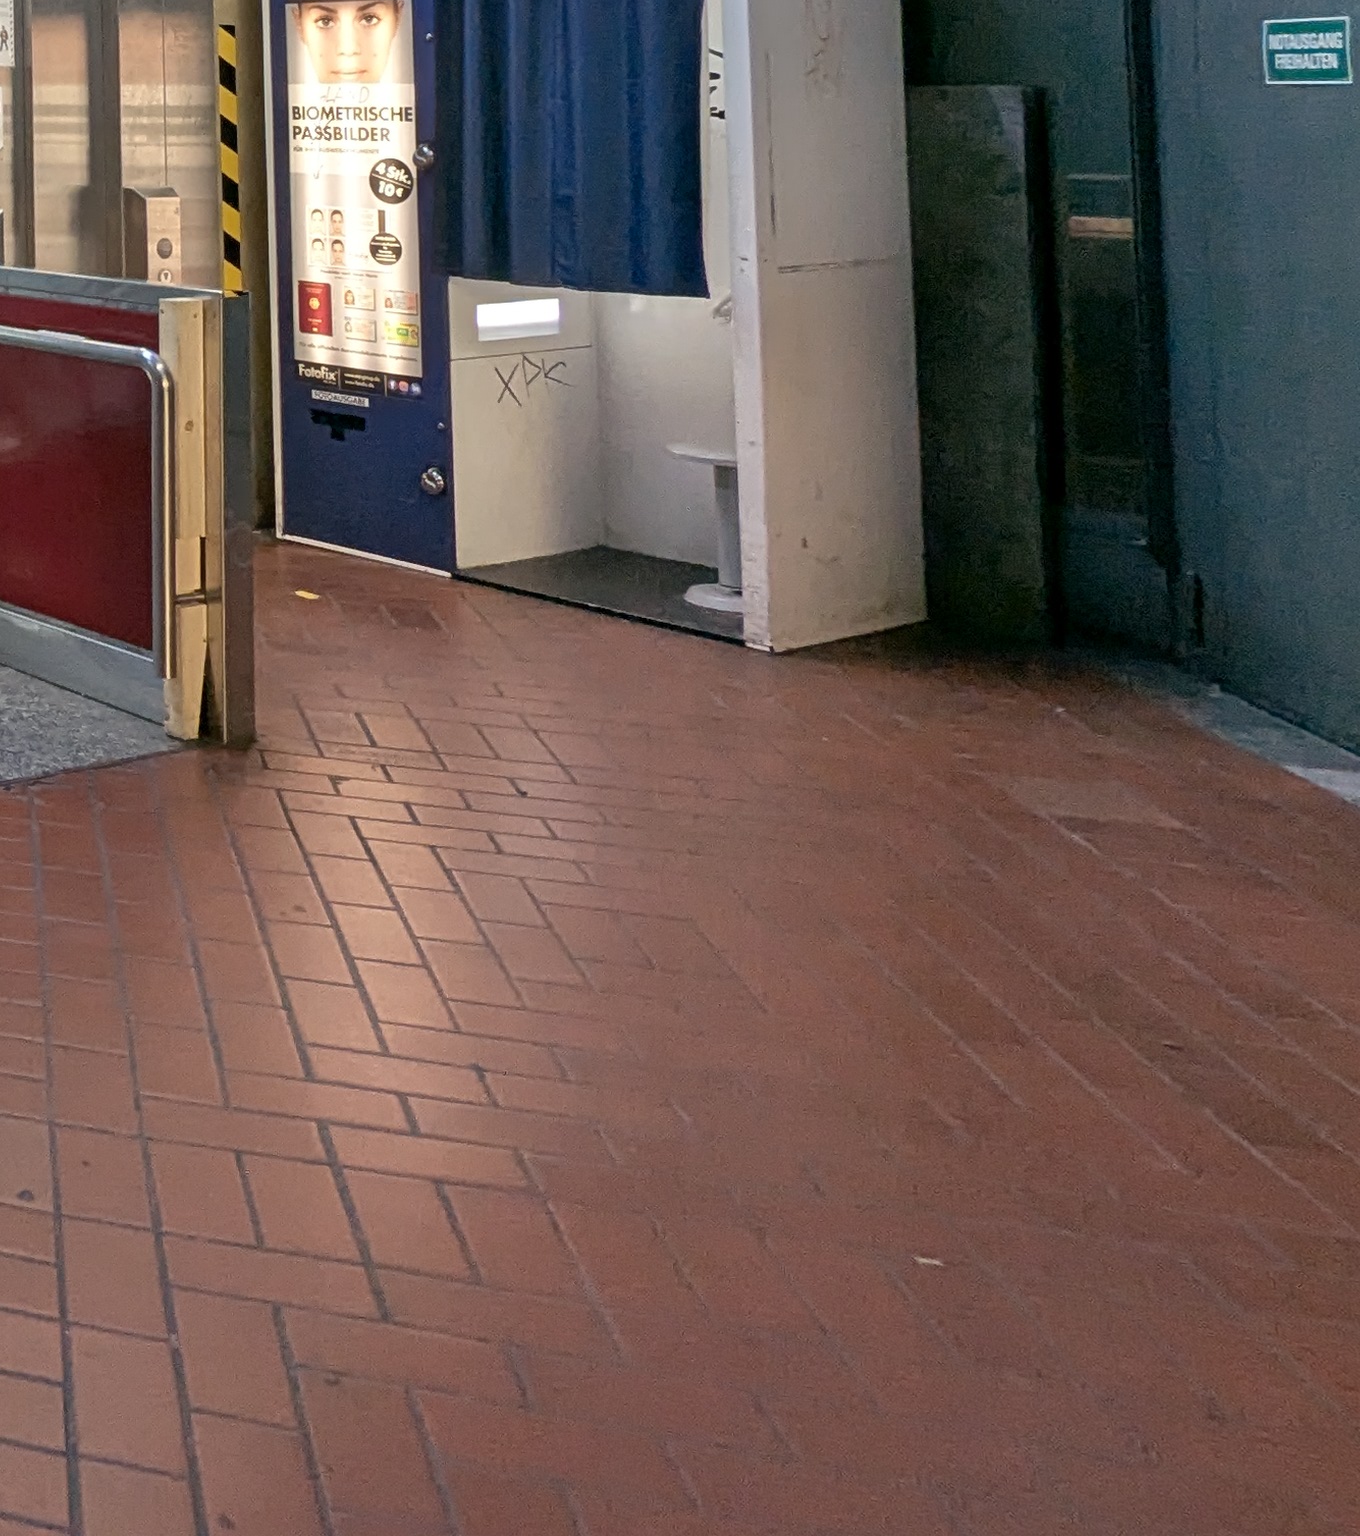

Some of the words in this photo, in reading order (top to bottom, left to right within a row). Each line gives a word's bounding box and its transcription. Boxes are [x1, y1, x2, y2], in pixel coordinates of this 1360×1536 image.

[1268, 32, 1343, 49] NOTAUSGANG
[1274, 52, 1339, 69] FREIHALTEN
[292, 105, 413, 122] BIOMETRISCHE
[292, 125, 390, 142] PASSBILDER
[375, 162, 386, 175] 4
[386, 165, 412, 185] Stk.
[298, 363, 336, 381] Fotofix
[313, 390, 367, 406] FOTOAUSGABE
